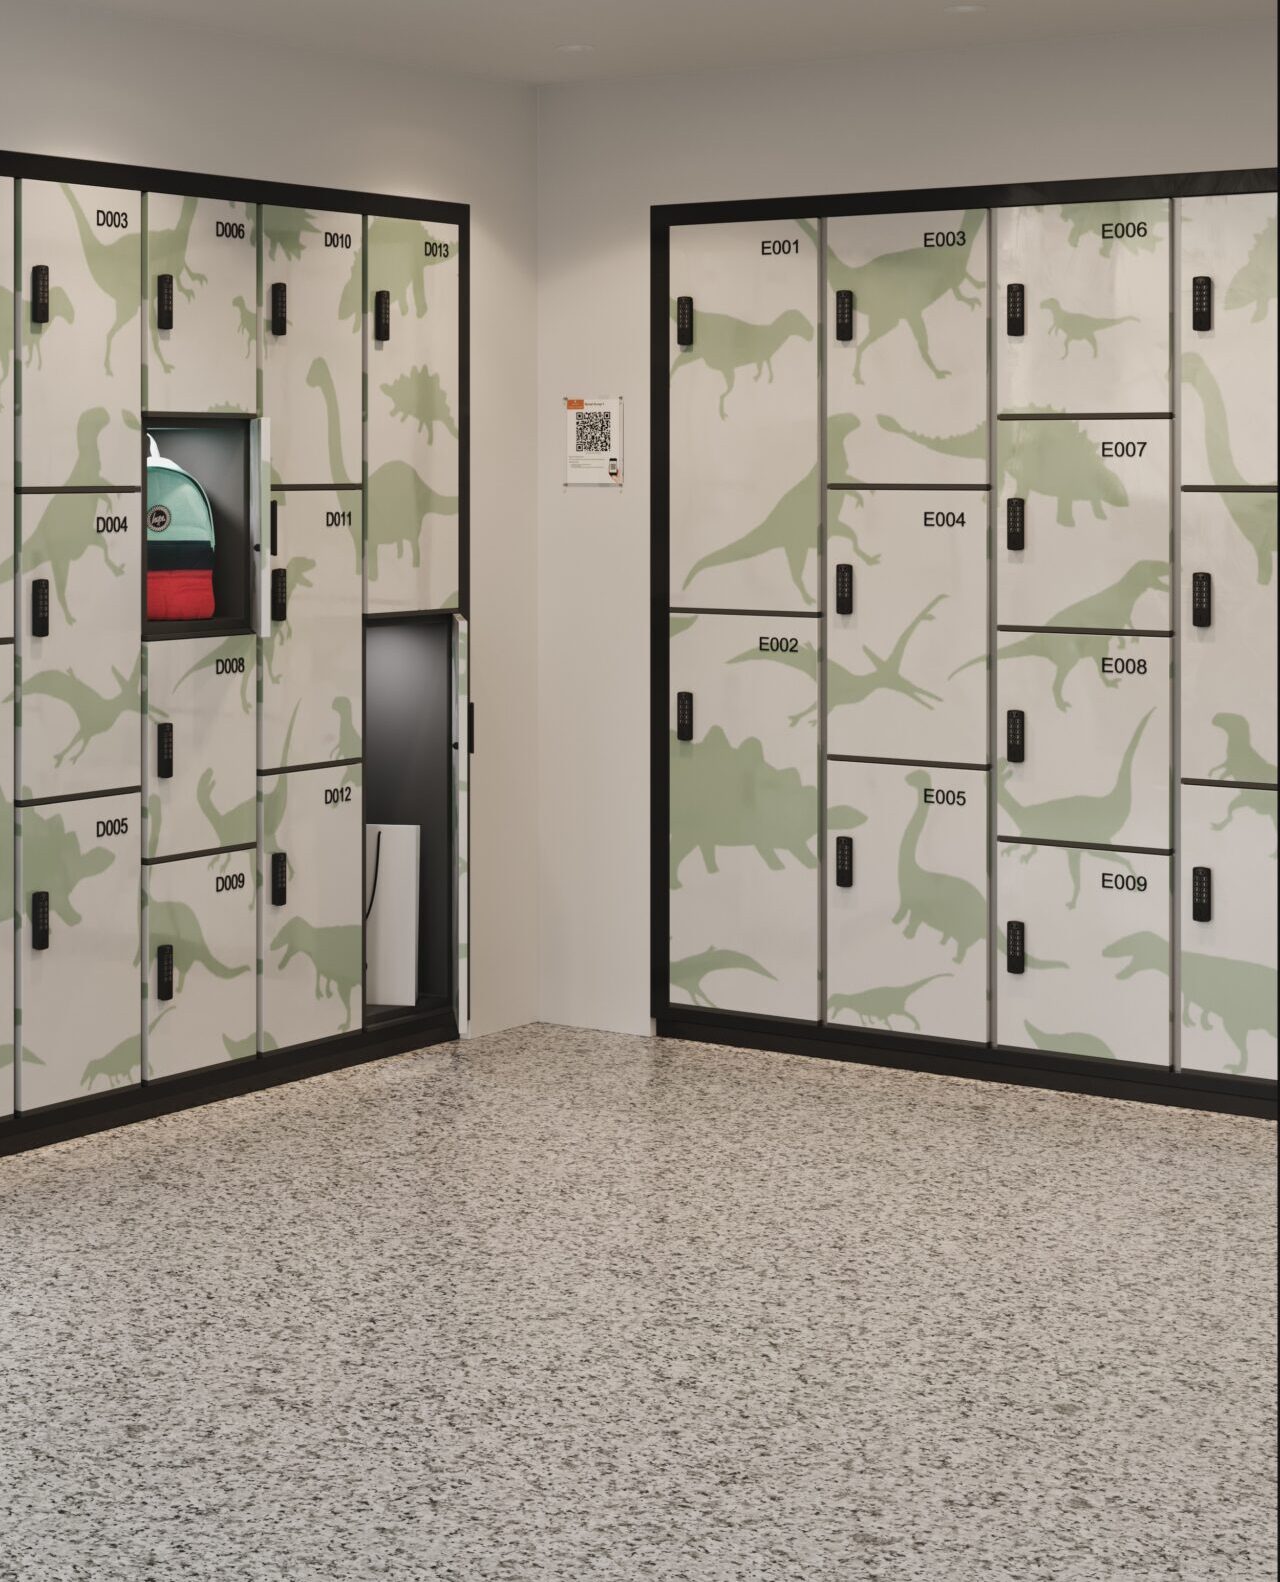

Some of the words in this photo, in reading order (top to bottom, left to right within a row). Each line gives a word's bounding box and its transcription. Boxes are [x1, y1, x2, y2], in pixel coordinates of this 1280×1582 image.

[96, 209, 129, 229] D003
[215, 220, 246, 240] D006
[923, 230, 967, 248] E003
[1101, 221, 1148, 240] E006
[324, 231, 352, 249] D010
[761, 239, 799, 256] E001
[424, 241, 450, 258] D013
[1101, 441, 1147, 458] E007
[96, 516, 128, 534] D004
[326, 511, 352, 527] D011
[923, 511, 966, 528] E004
[759, 636, 799, 653] E002
[215, 656, 245, 675] D008
[1101, 656, 1148, 675] E008
[324, 786, 352, 805] D012
[923, 788, 966, 806] E005
[96, 817, 129, 838] D005
[215, 872, 245, 893] D009
[1101, 872, 1148, 892] E009
